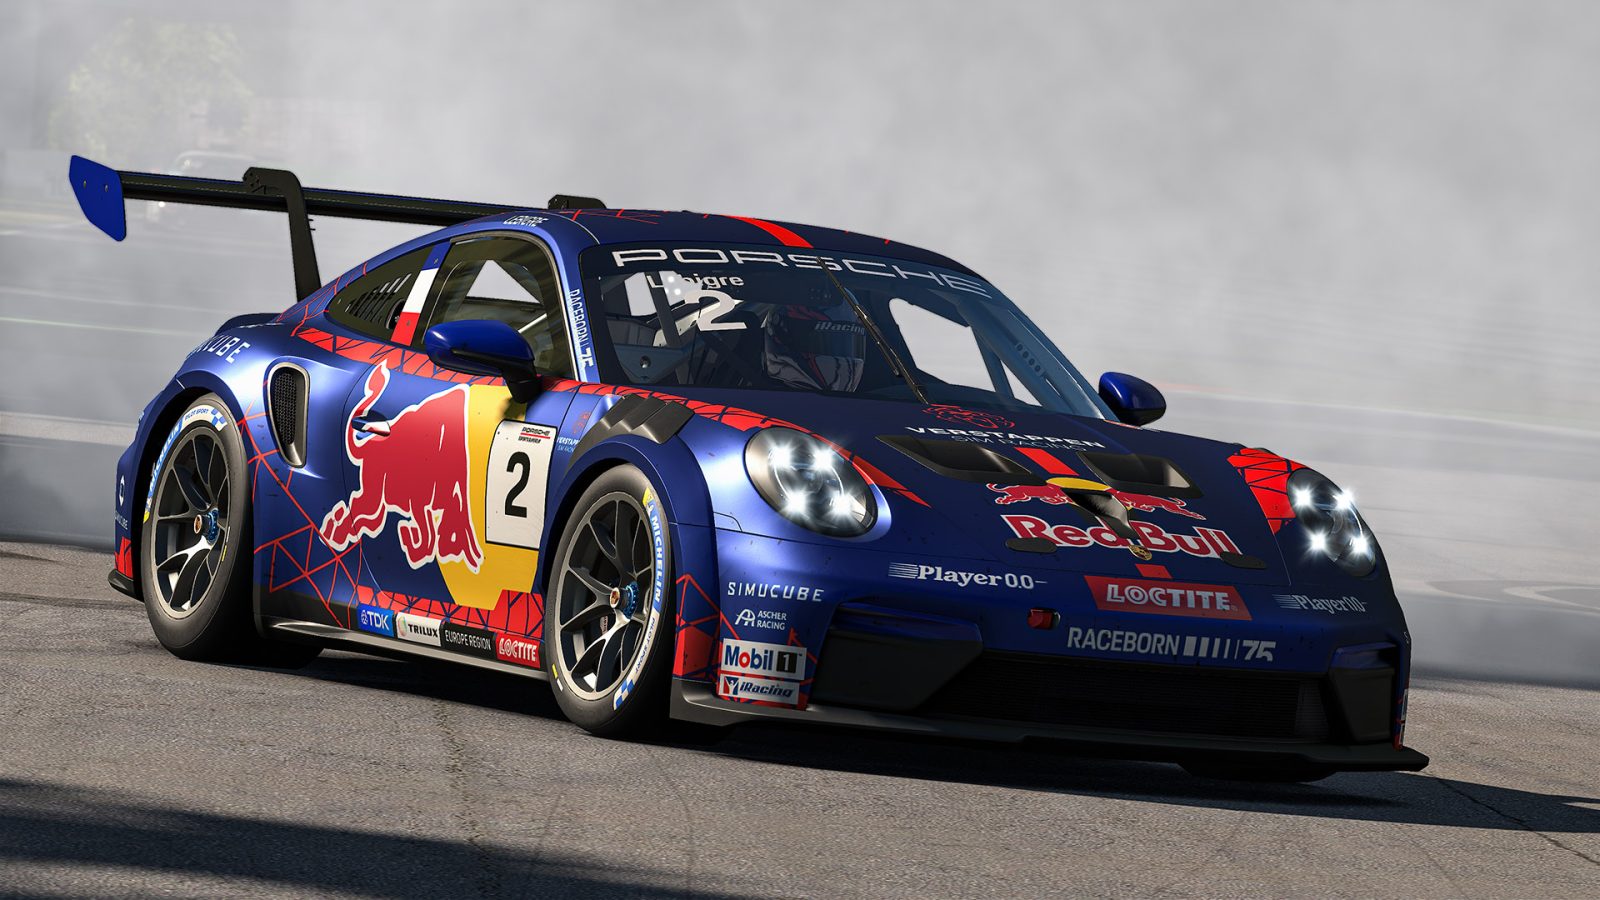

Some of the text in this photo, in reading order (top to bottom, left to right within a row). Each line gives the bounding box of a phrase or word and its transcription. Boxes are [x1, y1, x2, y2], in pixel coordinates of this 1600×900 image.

[612, 249, 992, 299] PORSCHE
[646, 273, 744, 289] Ligre
[684, 289, 747, 332] 2
[815, 320, 865, 336] iRacing
[522, 426, 551, 437] PORSCHE
[905, 426, 1106, 449] VERSTAPPEN
[951, 435, 1087, 452] SIM RACING
[505, 451, 531, 518] 2
[1001, 515, 1243, 559] Red Bull
[650, 517, 665, 603] MICHELIN
[917, 564, 1034, 590] Player 0.0
[727, 581, 825, 602] SIMUCUBE
[1106, 583, 1231, 611] LOCTITE
[1291, 594, 1349, 614] Player
[367, 612, 390, 631] TDK
[756, 619, 785, 631] RACING
[757, 610, 787, 621] ASCHER
[408, 623, 439, 638] TRILUX
[445, 629, 492, 650] EUROPE REGION
[499, 637, 538, 662] LOCTITE
[1067, 627, 1276, 662] RACEBORN 75
[724, 645, 774, 671] Mobil
[740, 681, 794, 698] iRacing
